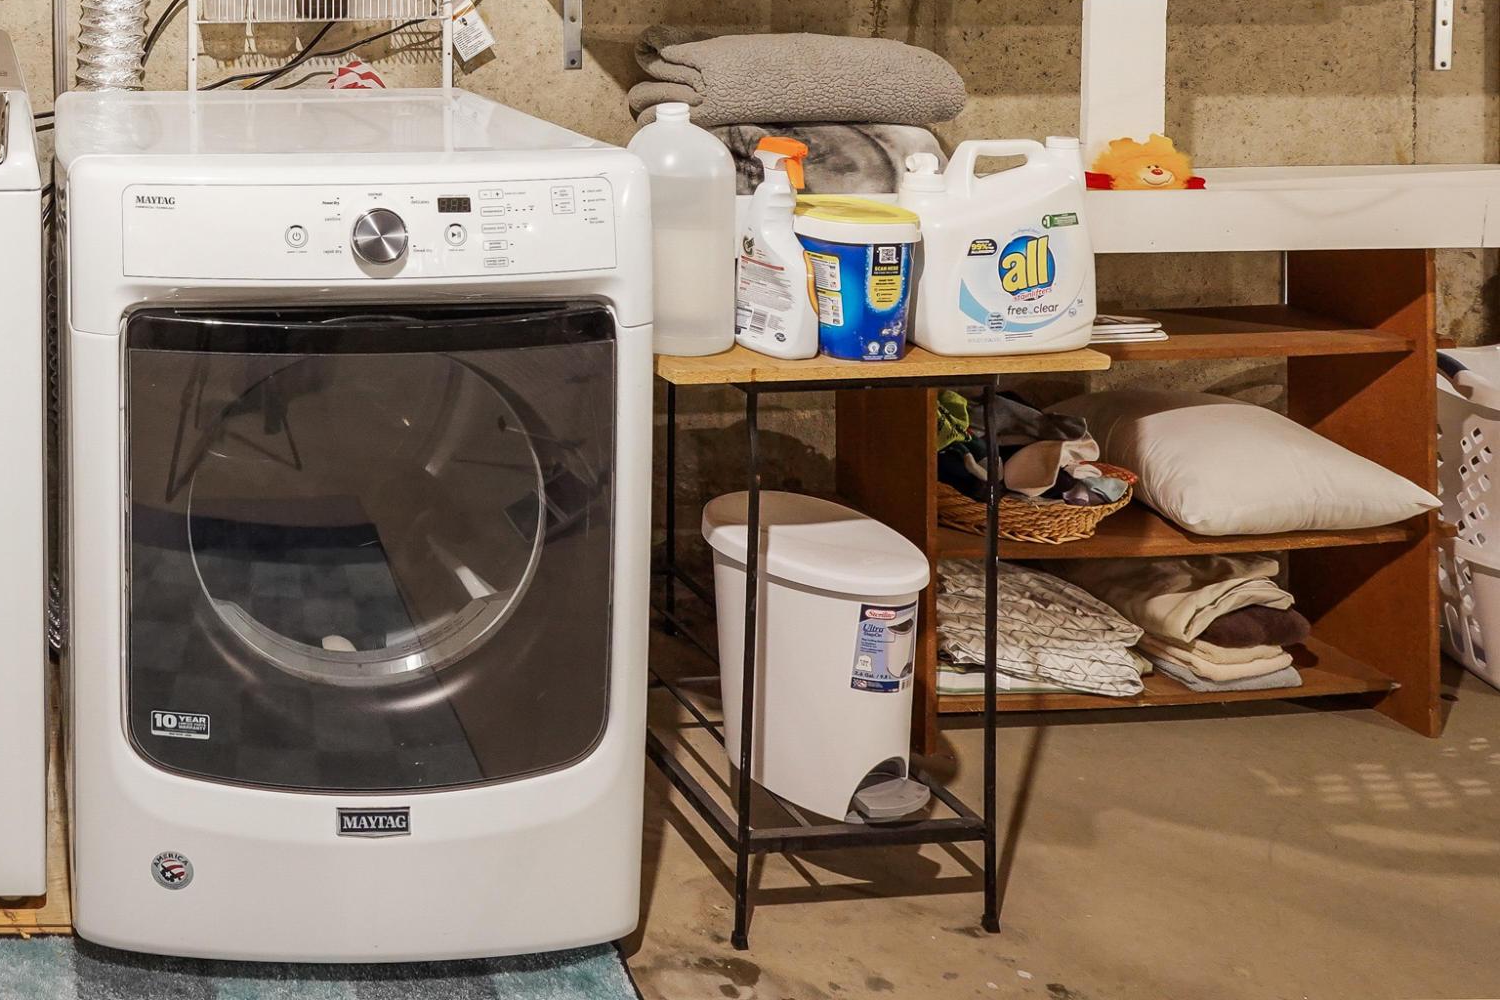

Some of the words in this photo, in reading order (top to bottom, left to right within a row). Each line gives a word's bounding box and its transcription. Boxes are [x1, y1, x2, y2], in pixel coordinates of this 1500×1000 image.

[135, 195, 176, 205] MAYTAG
[1001, 235, 1049, 292] all
[1013, 286, 1052, 302] stainlifters
[1007, 304, 1028, 316] free
[1033, 302, 1060, 314] clear
[863, 623, 885, 634] Ultra
[154, 713, 178, 728] 10
[179, 715, 206, 724] YEAR
[342, 816, 407, 829] MAYTAG
